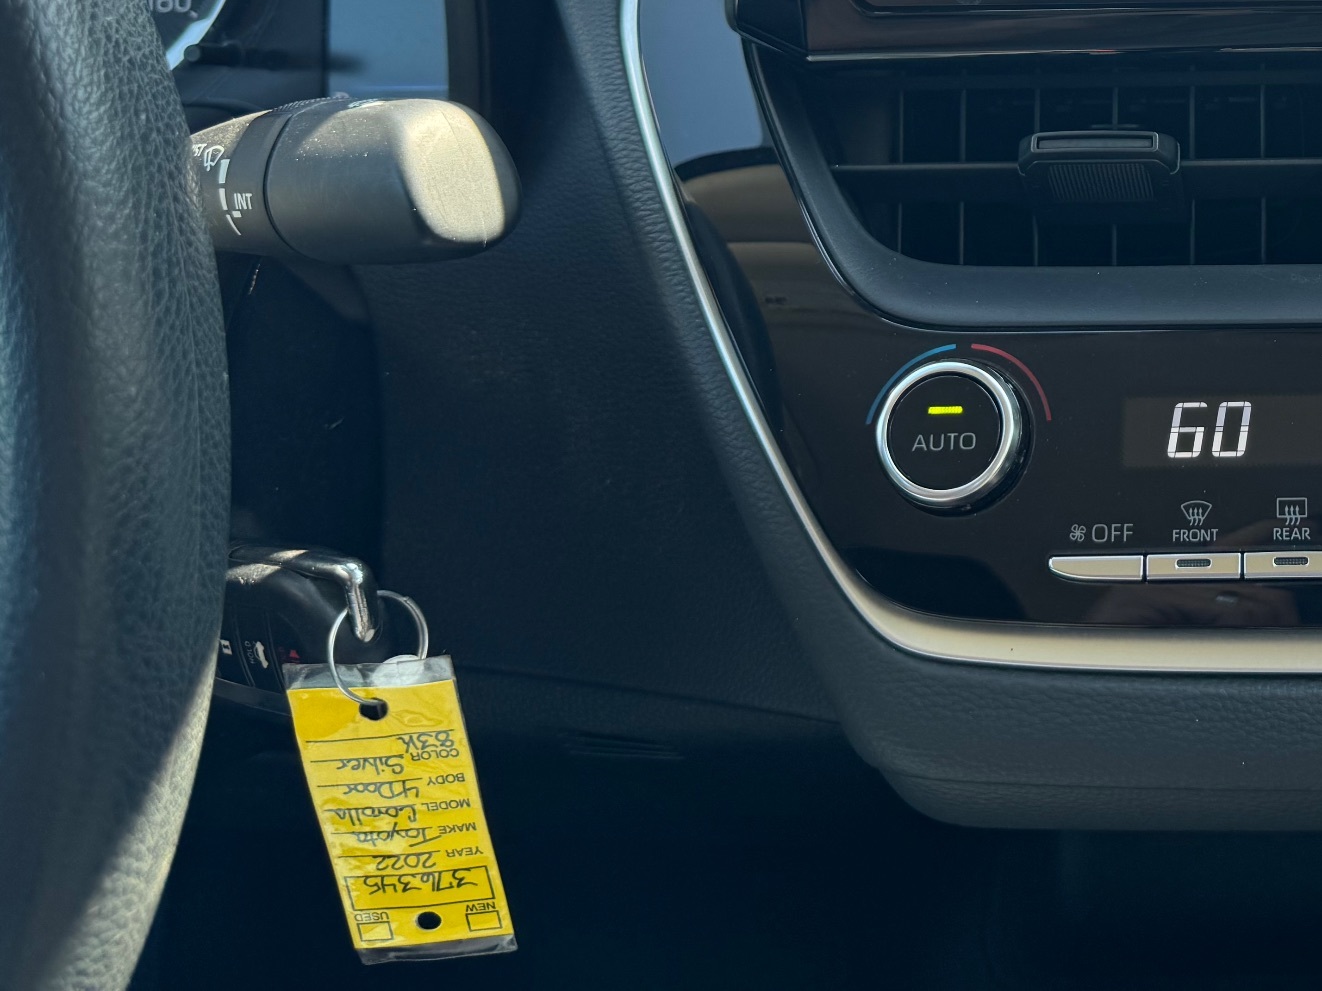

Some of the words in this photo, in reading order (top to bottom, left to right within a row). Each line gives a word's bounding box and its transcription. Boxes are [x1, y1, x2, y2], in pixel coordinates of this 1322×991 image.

[233, 193, 253, 210] INT
[1167, 401, 1252, 458] 60
[912, 432, 977, 452] AUTO
[1092, 524, 1134, 544] OFF
[1173, 529, 1219, 543] FRONT
[1273, 528, 1311, 541] REAR
[411, 749, 460, 761] COLOR
[426, 773, 466, 786] BODY
[421, 798, 471, 812] MODEL
[439, 822, 477, 836] MAKE
[445, 846, 484, 858] YEAR
[375, 854, 437, 870] 2022
[465, 901, 496, 913] NEW
[354, 911, 390, 922] USED
